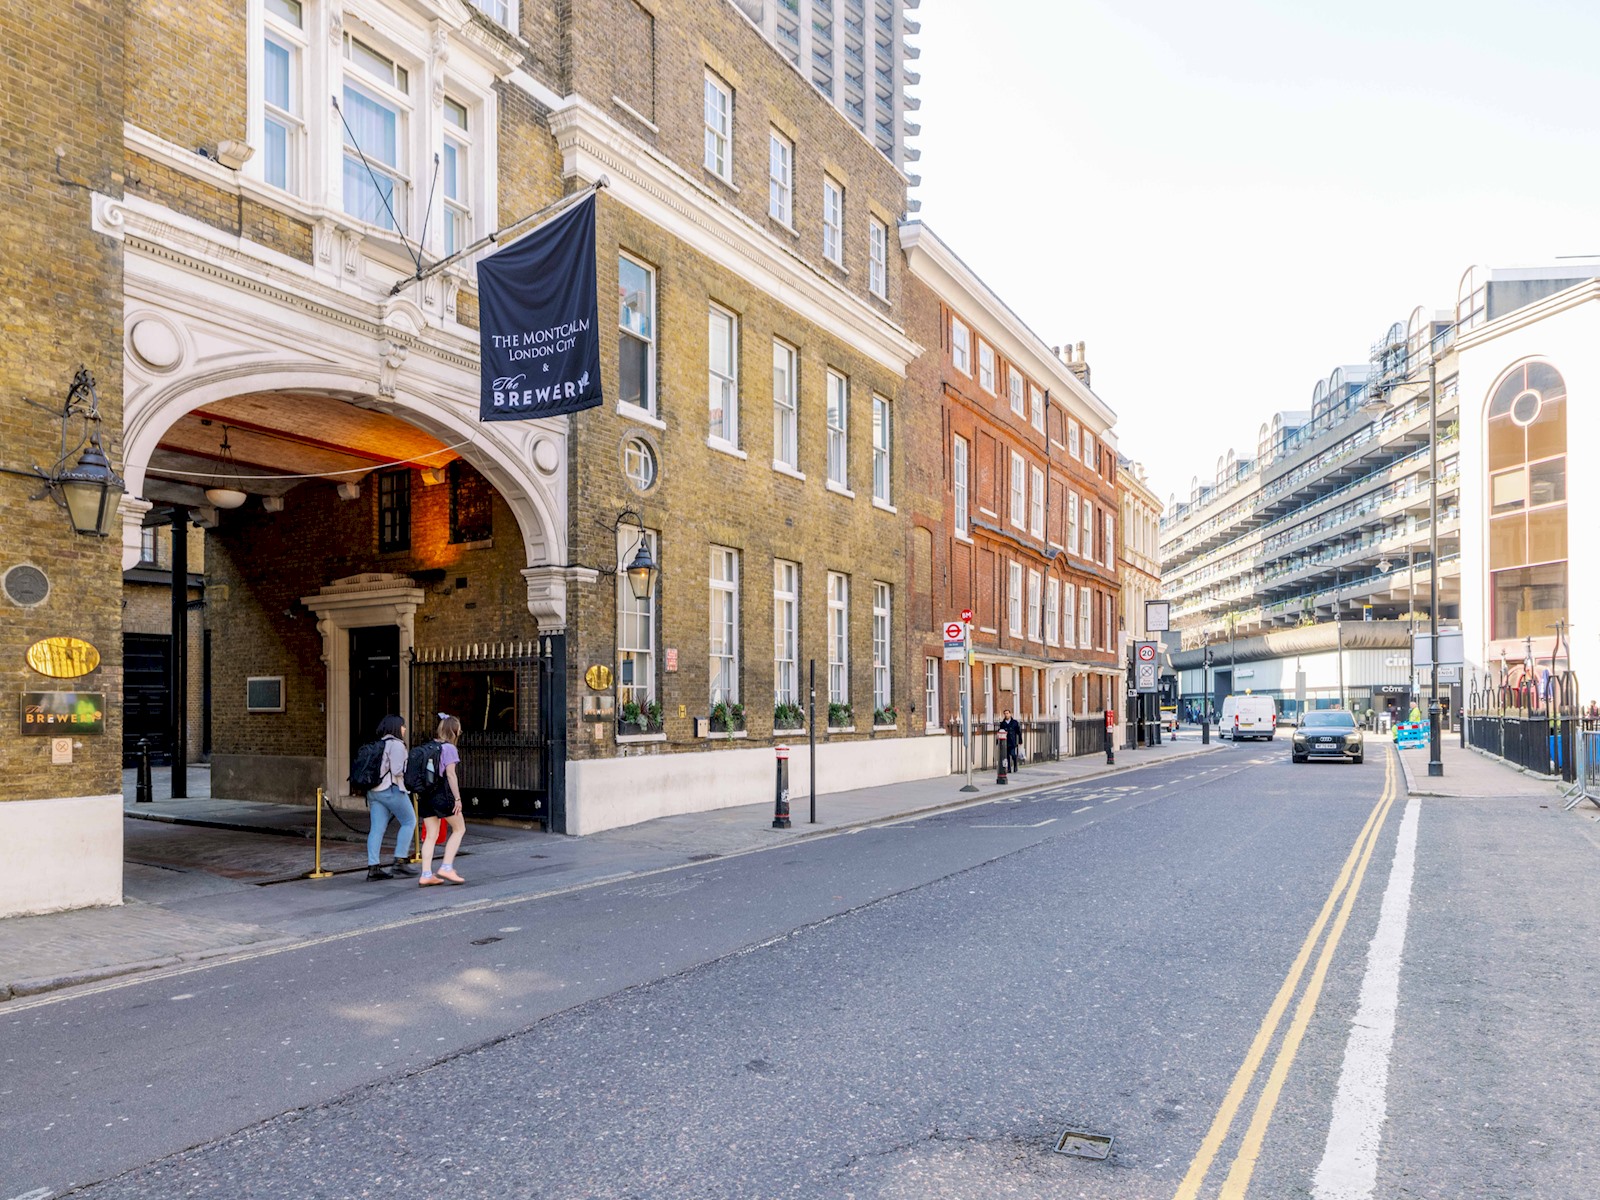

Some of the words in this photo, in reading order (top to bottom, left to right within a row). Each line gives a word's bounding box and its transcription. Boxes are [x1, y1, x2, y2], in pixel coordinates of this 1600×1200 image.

[492, 334, 519, 348] THE
[523, 318, 590, 346] MONTCALM
[509, 344, 554, 361] LONDON
[556, 336, 577, 353] CITY
[542, 363, 549, 372] &
[492, 373, 527, 390] The
[493, 379, 588, 406] BREWERY
[1141, 649, 1152, 657] 20
[1385, 653, 1411, 666] cin
[26, 713, 98, 723] BREWERY
